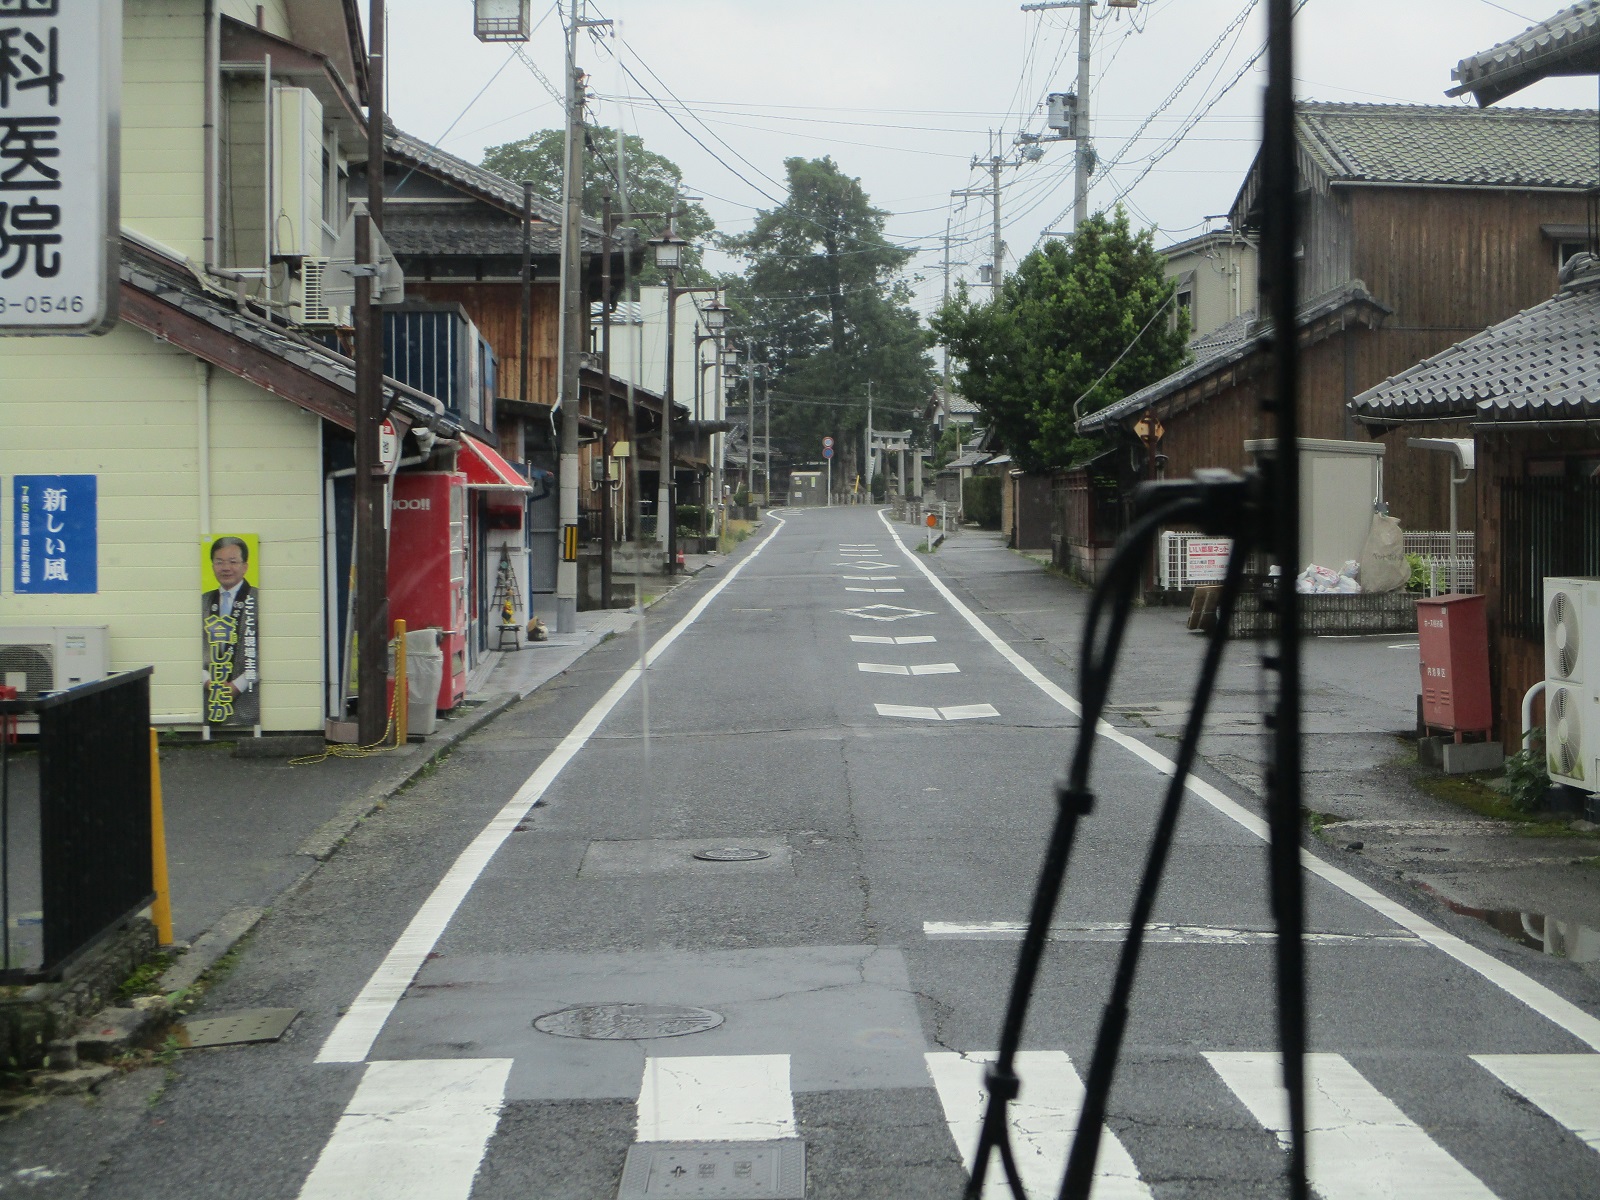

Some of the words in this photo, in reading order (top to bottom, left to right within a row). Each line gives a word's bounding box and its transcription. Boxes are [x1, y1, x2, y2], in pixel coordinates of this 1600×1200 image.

[0, 0, 65, 280] 科医院
[42, 487, 69, 581] 新しい風
[203, 614, 239, 722] 谷しげたか
